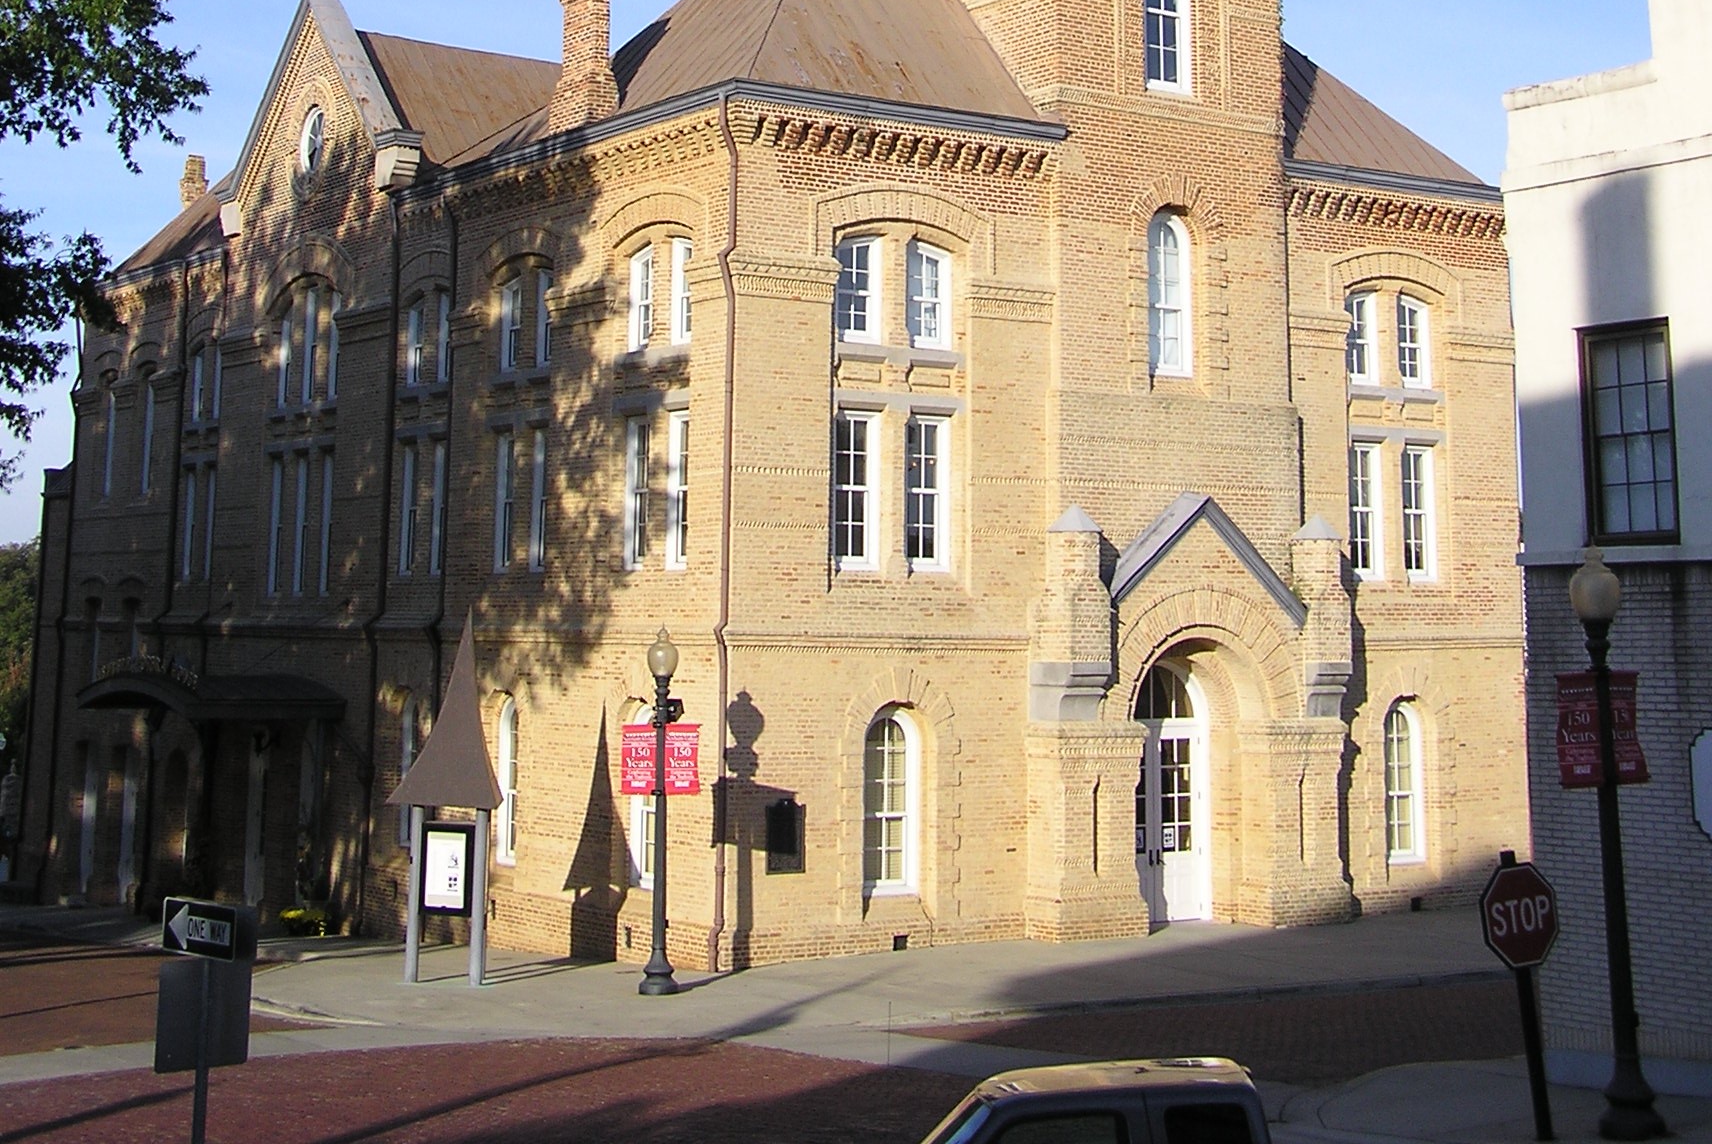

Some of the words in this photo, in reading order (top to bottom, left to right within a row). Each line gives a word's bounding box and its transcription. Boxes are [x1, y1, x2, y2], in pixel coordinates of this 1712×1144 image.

[1567, 711, 1591, 726] 150
[1561, 728, 1597, 743] Years
[631, 747, 651, 758] 150
[673, 747, 692, 758] 150
[625, 757, 654, 768] Years
[668, 757, 695, 768] Years
[1491, 895, 1550, 936] STOP
[187, 918, 206, 939] ONE
[209, 921, 228, 944] WAY
